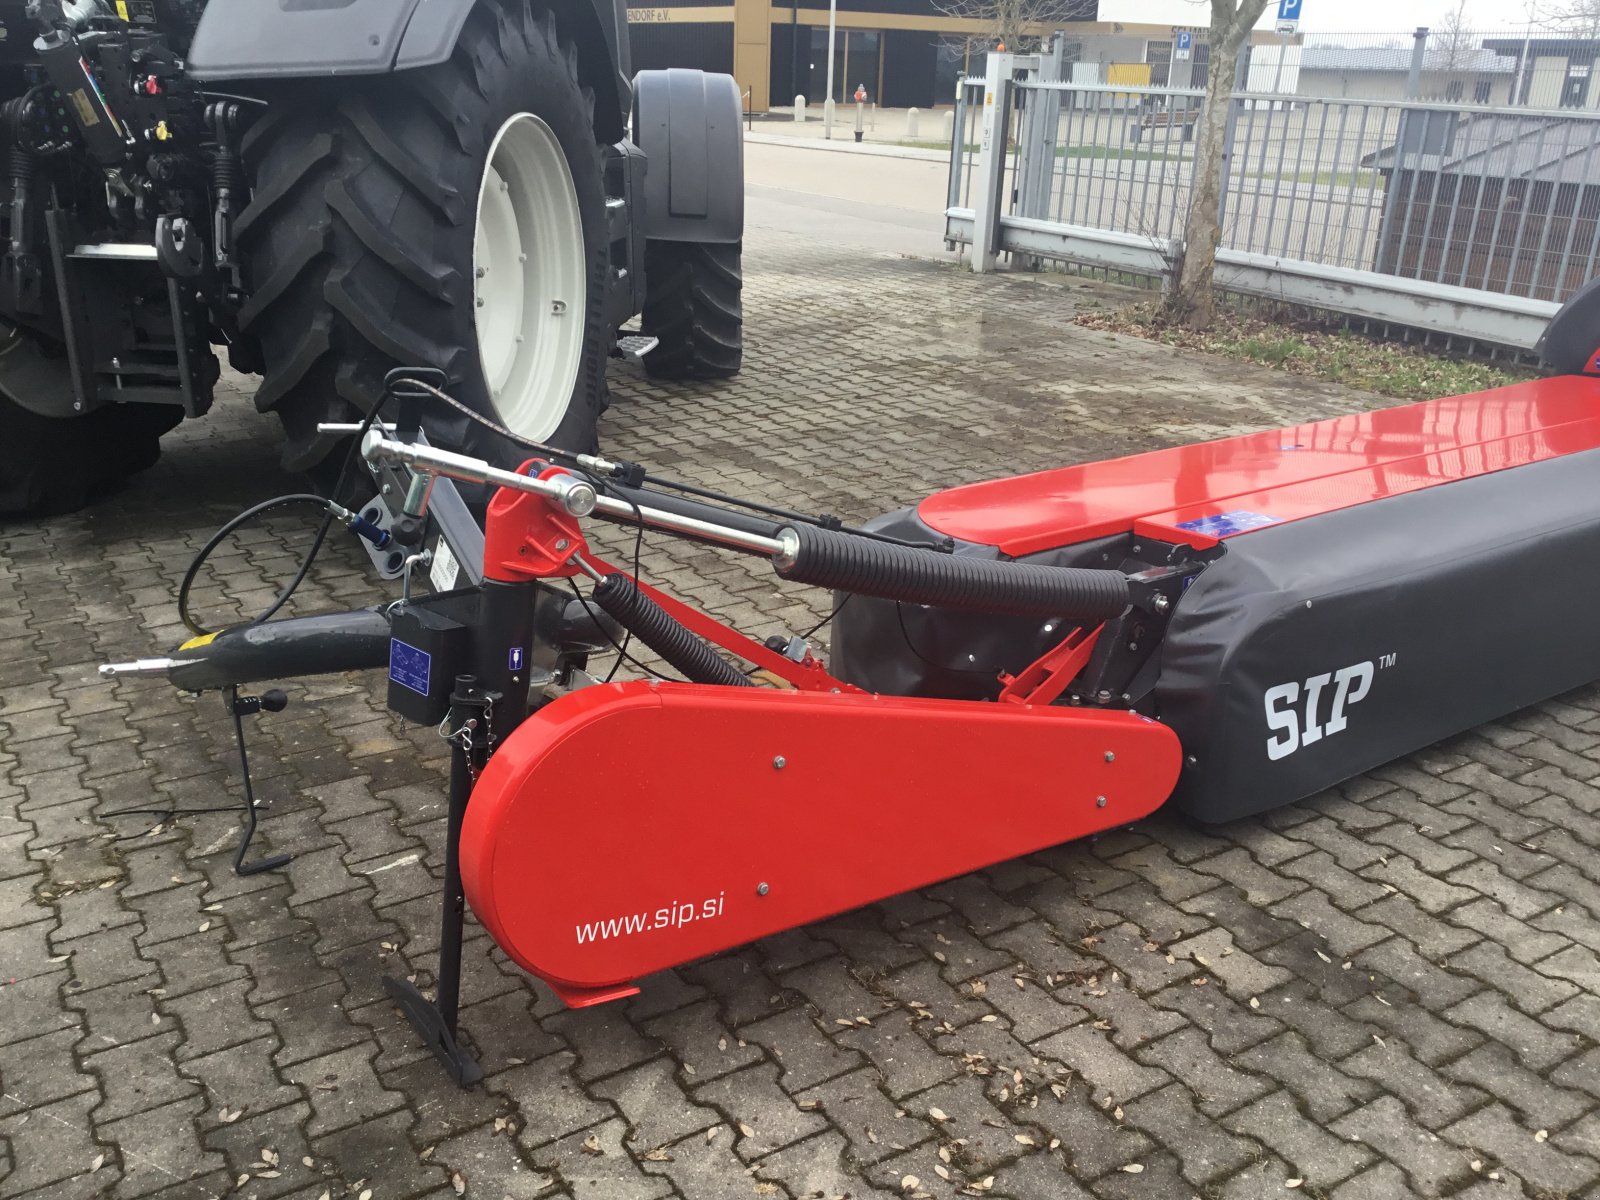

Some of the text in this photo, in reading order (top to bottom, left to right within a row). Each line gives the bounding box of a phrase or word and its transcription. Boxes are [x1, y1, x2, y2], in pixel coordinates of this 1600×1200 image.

[627, 9, 671, 21] ENDORF e.V.
[1282, 0, 1298, 17] P
[1180, 33, 1189, 48] P
[1264, 660, 1375, 761] SIP
[575, 891, 724, 944] www.sip.si
